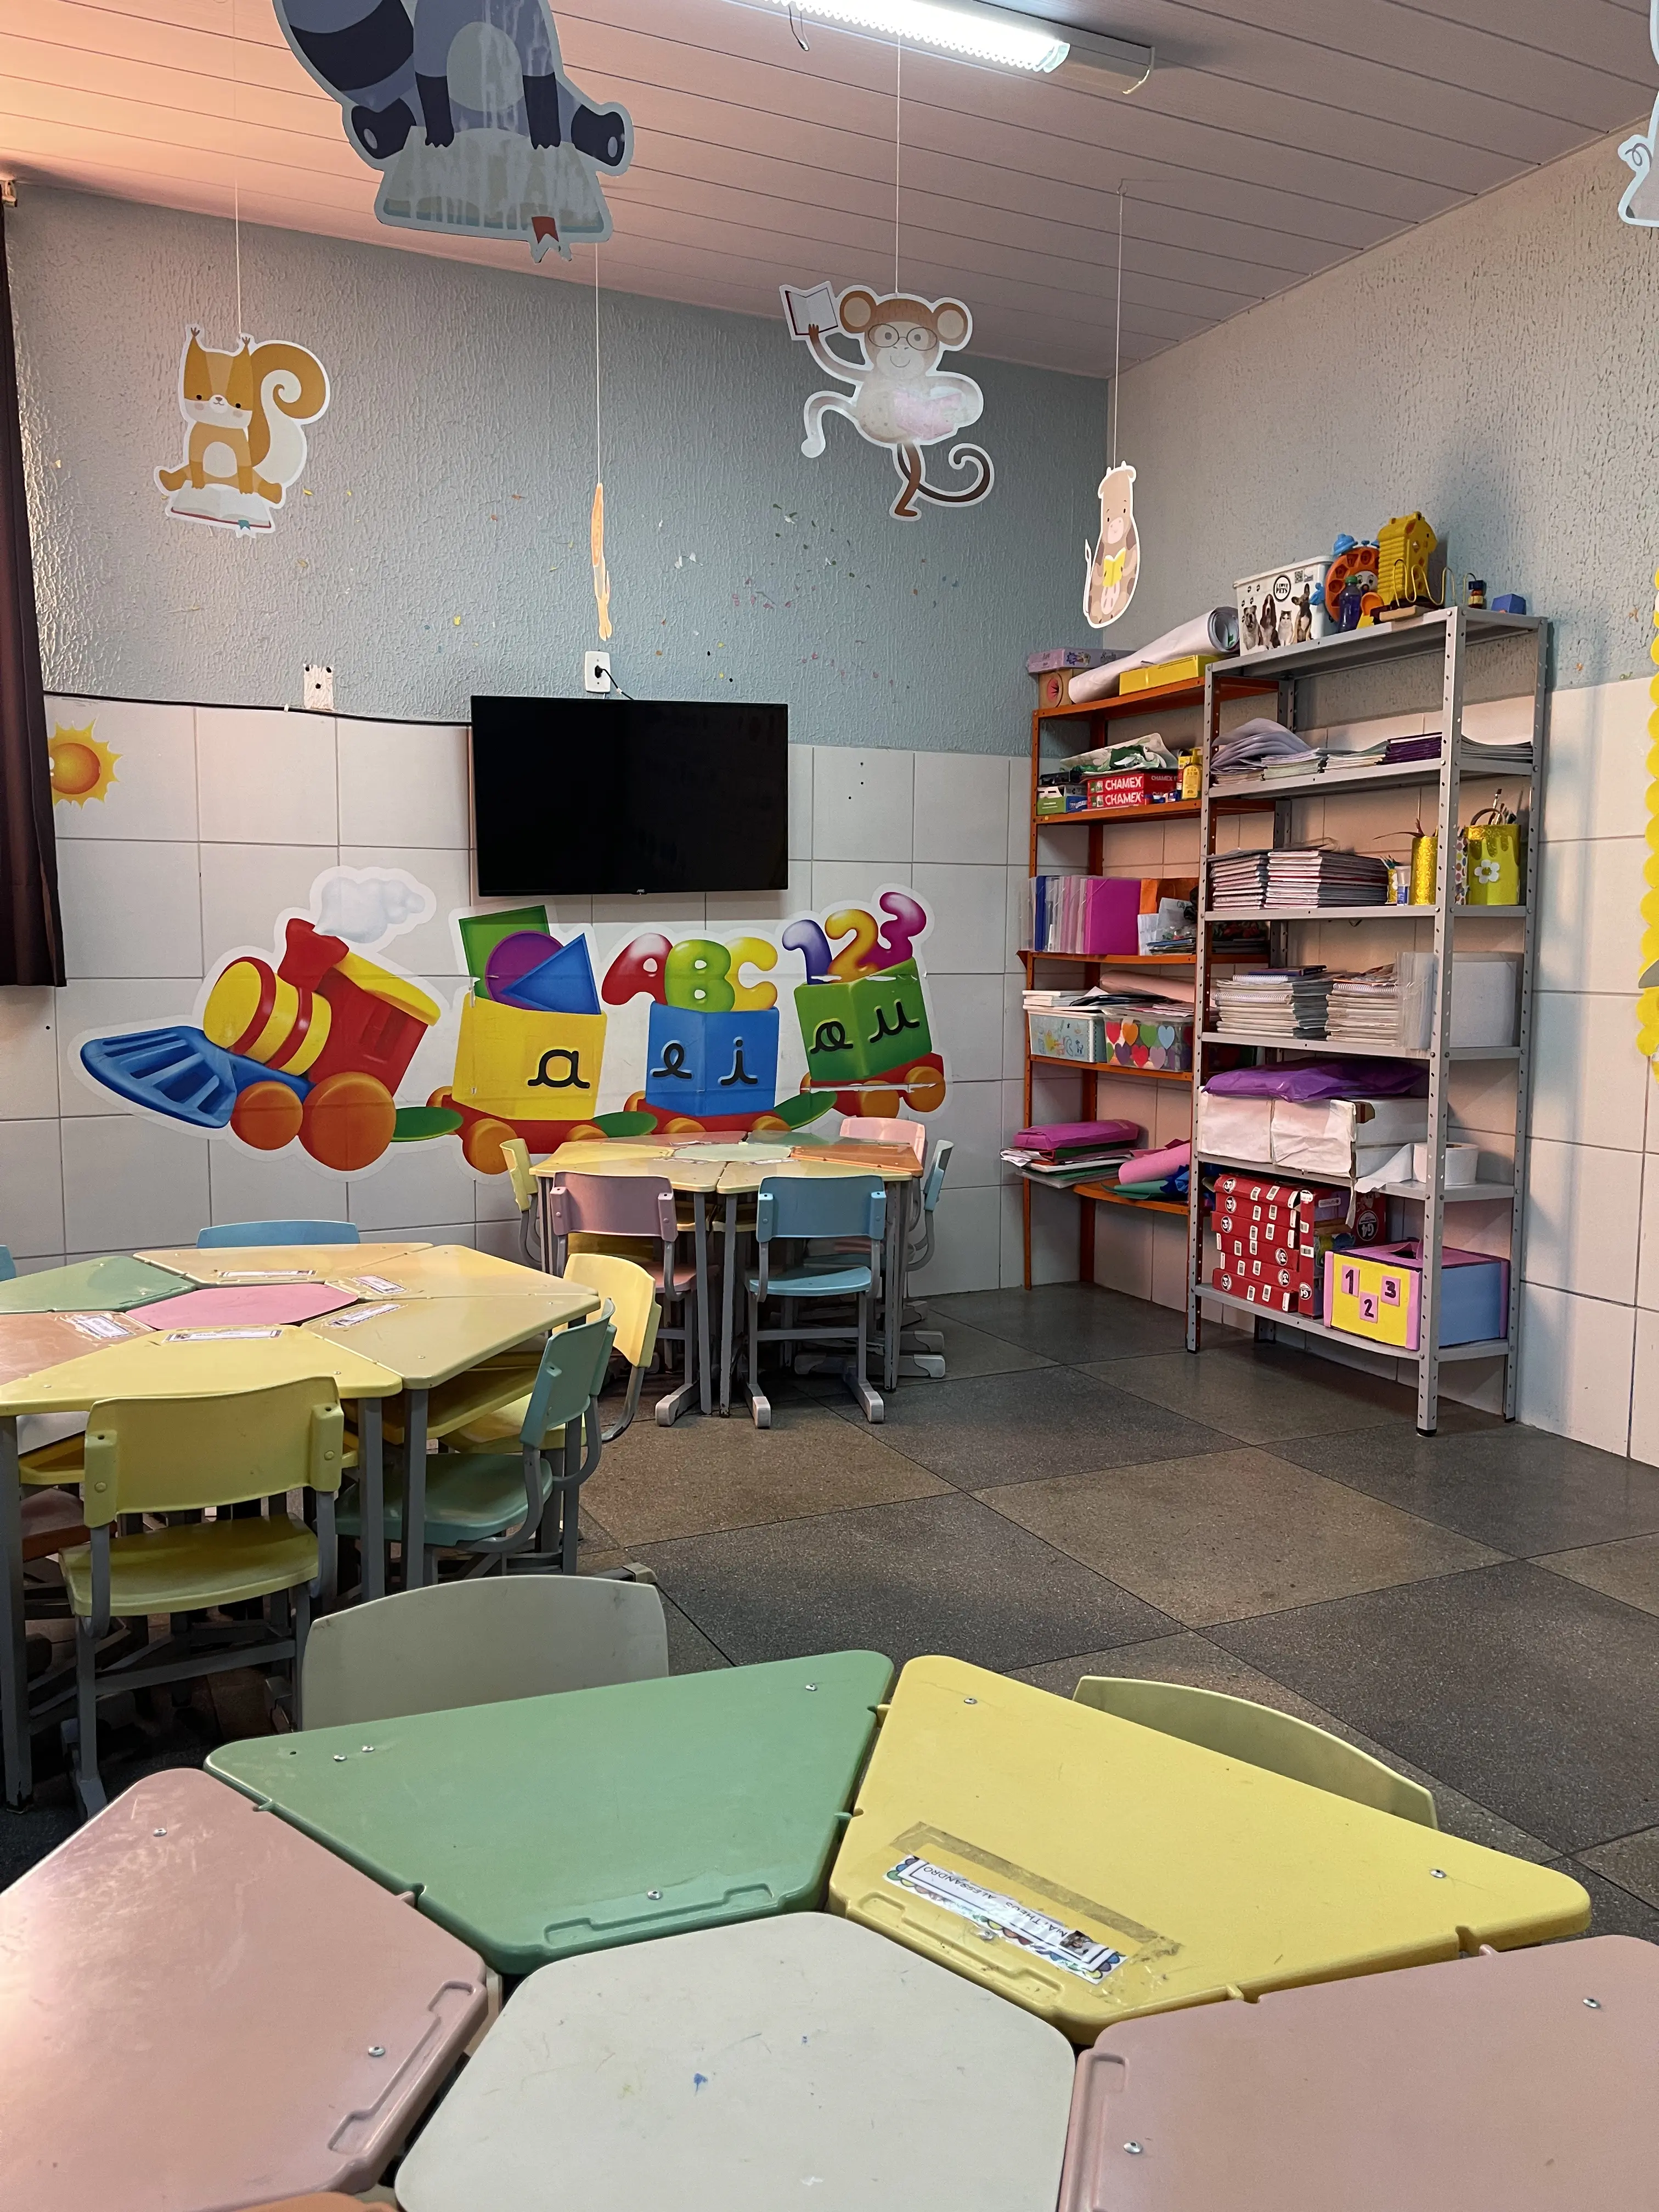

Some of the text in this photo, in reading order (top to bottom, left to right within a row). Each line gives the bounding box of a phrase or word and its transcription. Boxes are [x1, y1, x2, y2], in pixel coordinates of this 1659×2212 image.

[1105, 776, 1143, 790] CHAMEX
[1105, 792, 1142, 805] CHAMEX
[601, 933, 778, 1012] ABC
[527, 1048, 590, 1088] a
[652, 1039, 758, 1085] e i
[1362, 1223, 1374, 1237] G4
[1346, 1269, 1353, 1295] 1
[1385, 1280, 1396, 1298] 3
[1364, 1299, 1374, 1318] 2
[923, 1866, 996, 1899] ALESSANDRO
